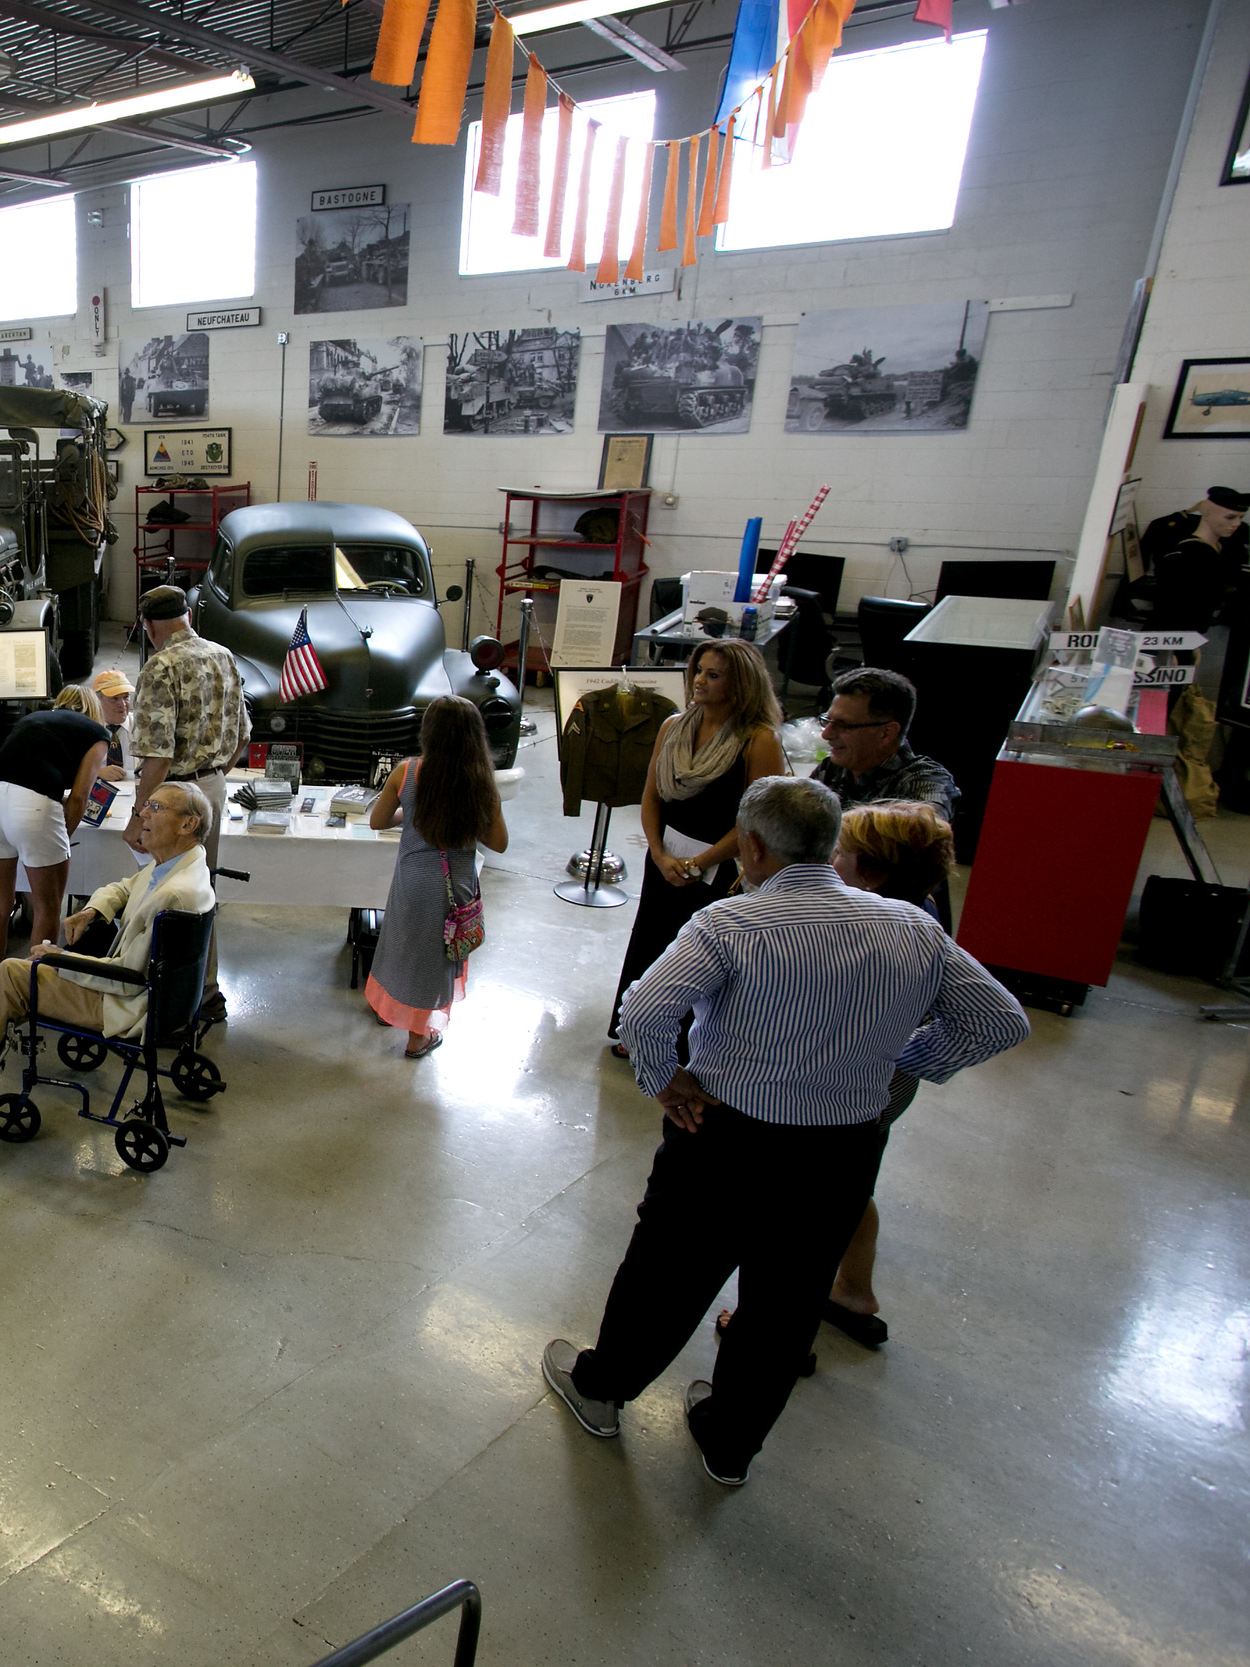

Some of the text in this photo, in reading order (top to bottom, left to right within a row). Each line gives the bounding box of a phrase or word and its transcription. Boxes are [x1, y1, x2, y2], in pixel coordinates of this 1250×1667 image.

[319, 191, 376, 206] BASTOGNE
[197, 313, 250, 326] NEUFCHATEAU
[1143, 636, 1158, 646] 23
[1163, 636, 1183, 646] KM
